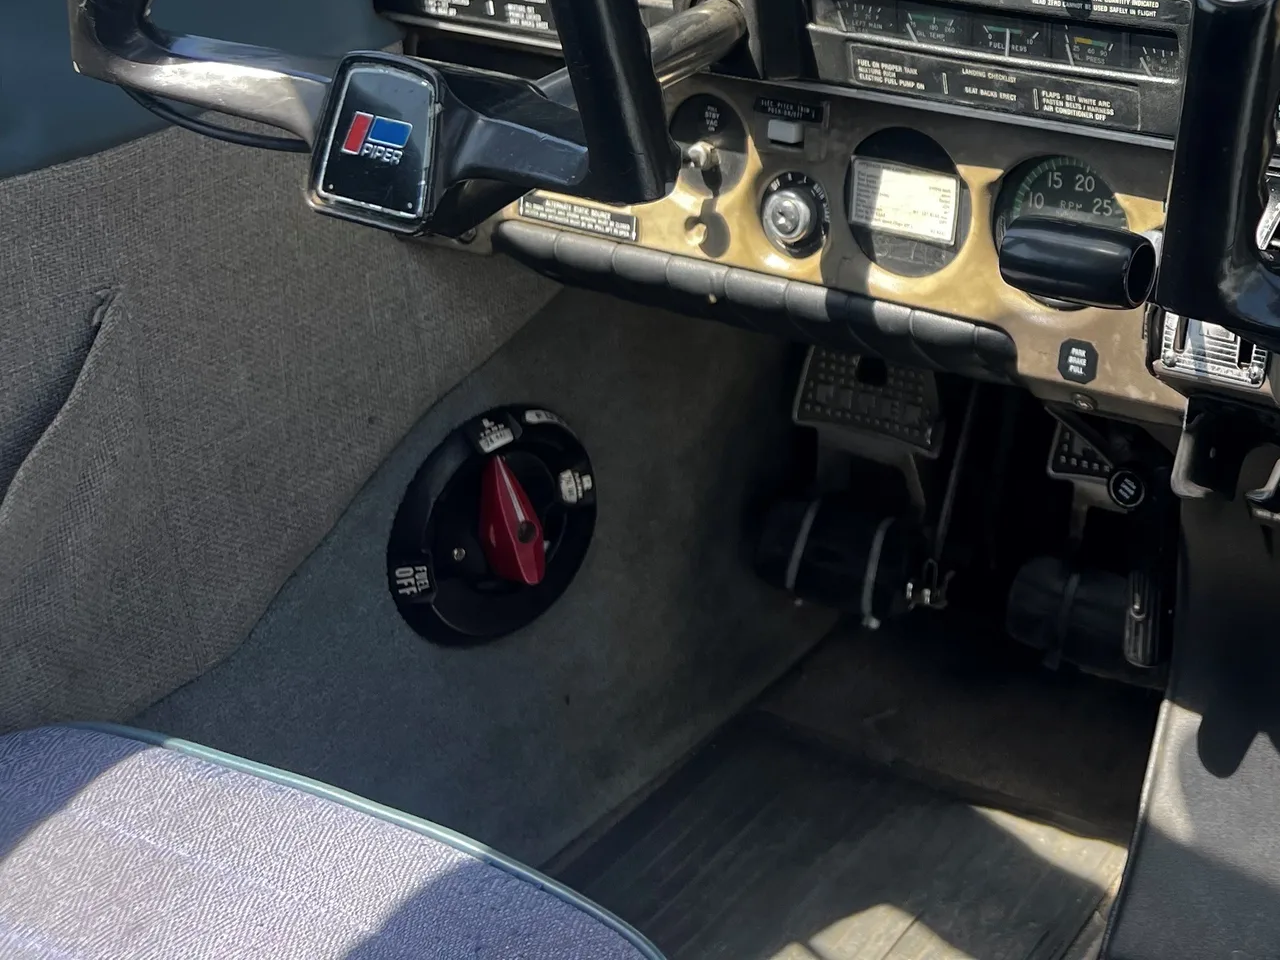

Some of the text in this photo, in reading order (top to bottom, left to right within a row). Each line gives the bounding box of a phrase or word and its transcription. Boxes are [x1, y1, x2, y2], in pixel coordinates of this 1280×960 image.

[1109, 6, 1128, 15] SAFELY
[1137, 9, 1157, 18] FLIGHT
[1132, 0, 1159, 8] INDICATED
[361, 142, 403, 165] PIPER
[1048, 172, 1063, 189] 15
[1075, 174, 1095, 192] 20
[1029, 192, 1044, 209] 10
[1093, 198, 1113, 216] 25
[1068, 355, 1087, 366] BRAKE
[1071, 348, 1087, 358] PARK
[395, 567, 417, 596] OFF
[414, 565, 430, 592] FUEL
